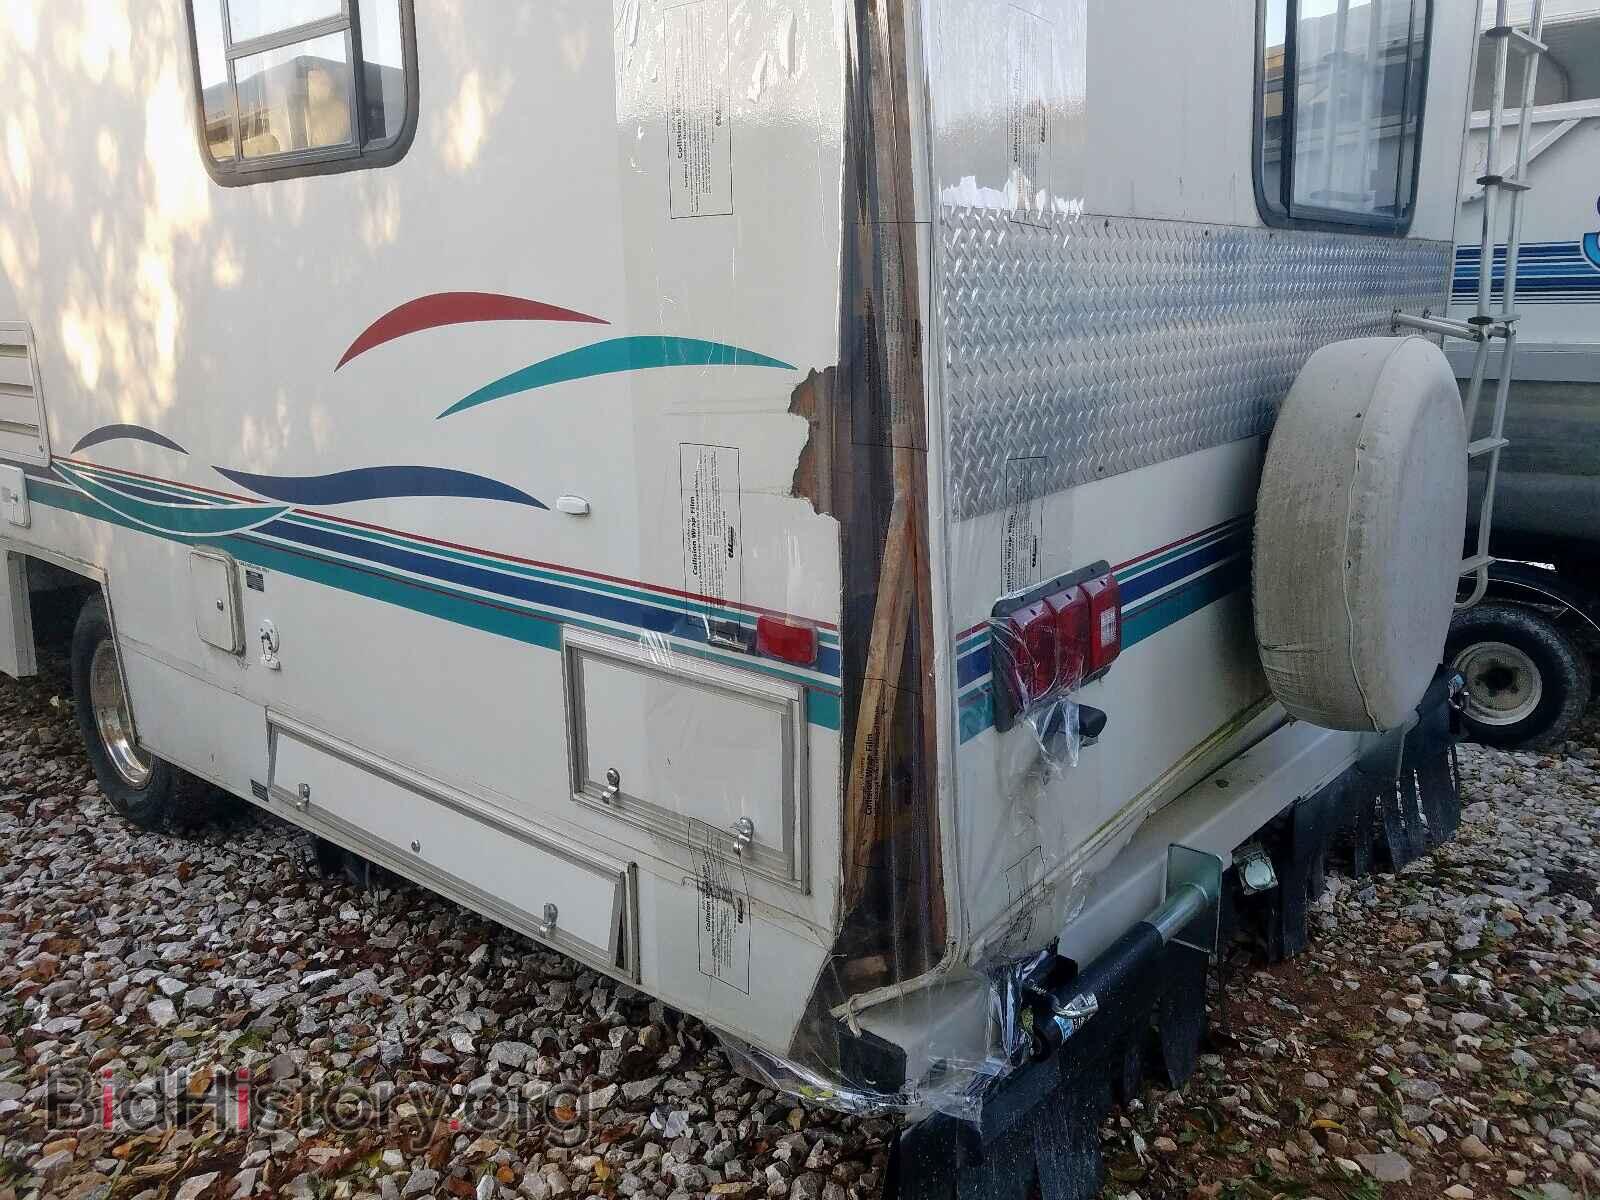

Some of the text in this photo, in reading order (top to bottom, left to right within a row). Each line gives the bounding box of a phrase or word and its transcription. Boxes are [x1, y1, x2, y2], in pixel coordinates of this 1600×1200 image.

[676, 120, 684, 159] Collision
[690, 517, 698, 539] Wrap
[865, 733, 873, 752] Film
[864, 780, 873, 816] Collision
